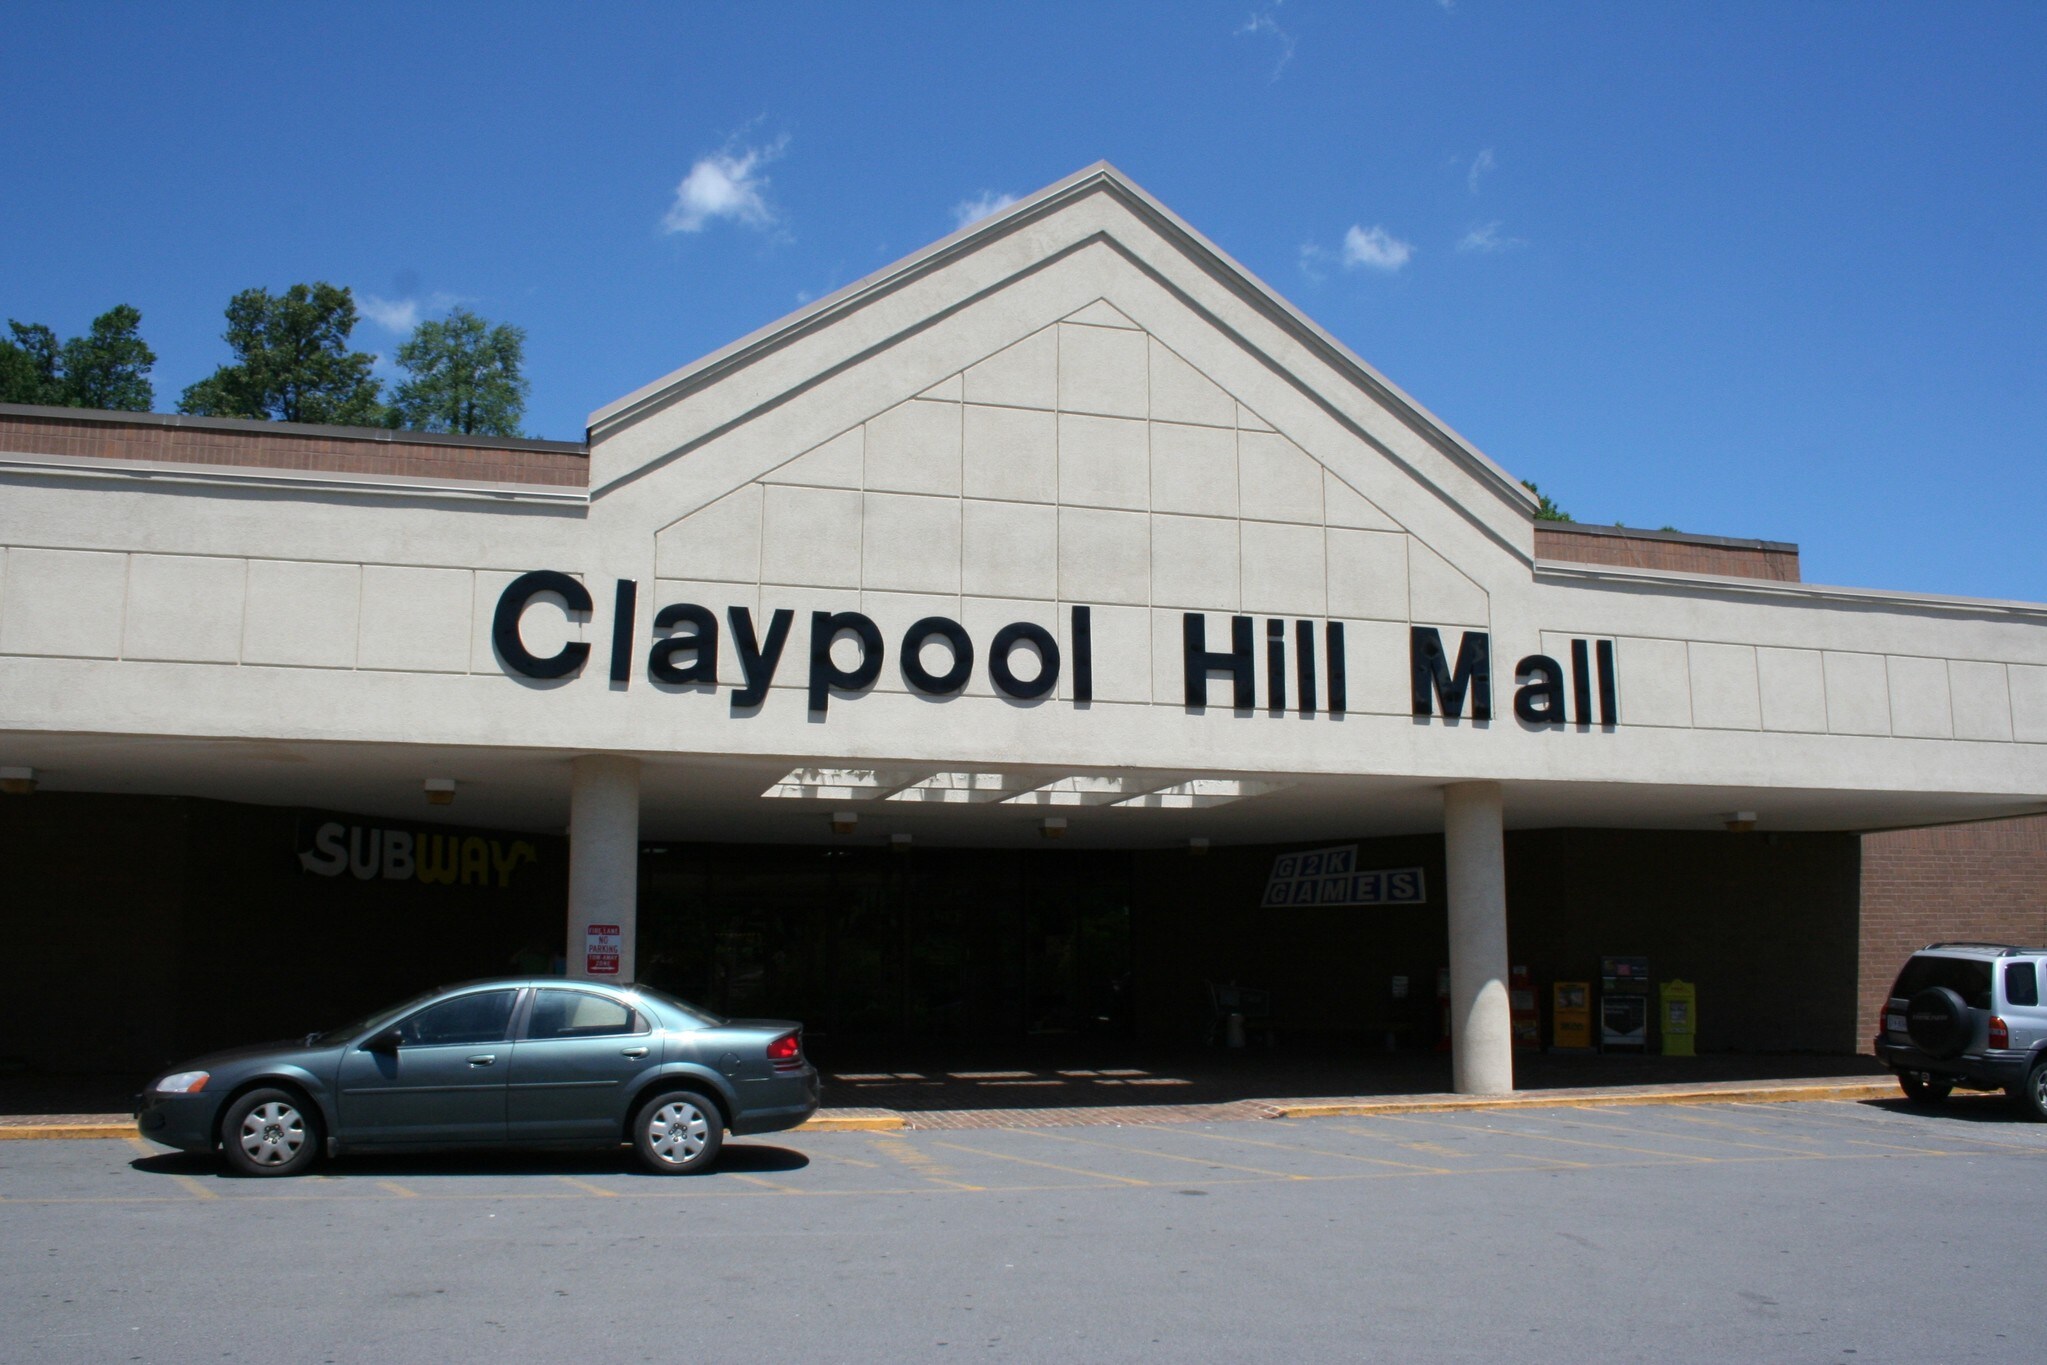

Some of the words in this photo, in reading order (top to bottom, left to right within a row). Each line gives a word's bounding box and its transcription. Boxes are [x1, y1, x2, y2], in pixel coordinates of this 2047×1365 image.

[492, 569, 1093, 711] Claypool
[1183, 612, 1347, 713] Hill
[1411, 626, 1617, 726] Mall
[297, 821, 539, 889] SUBWAY
[1277, 851, 1345, 878] G2K
[1270, 873, 1416, 903] GAMES
[588, 944, 619, 953] PARKING
[598, 936, 609, 944] NO
